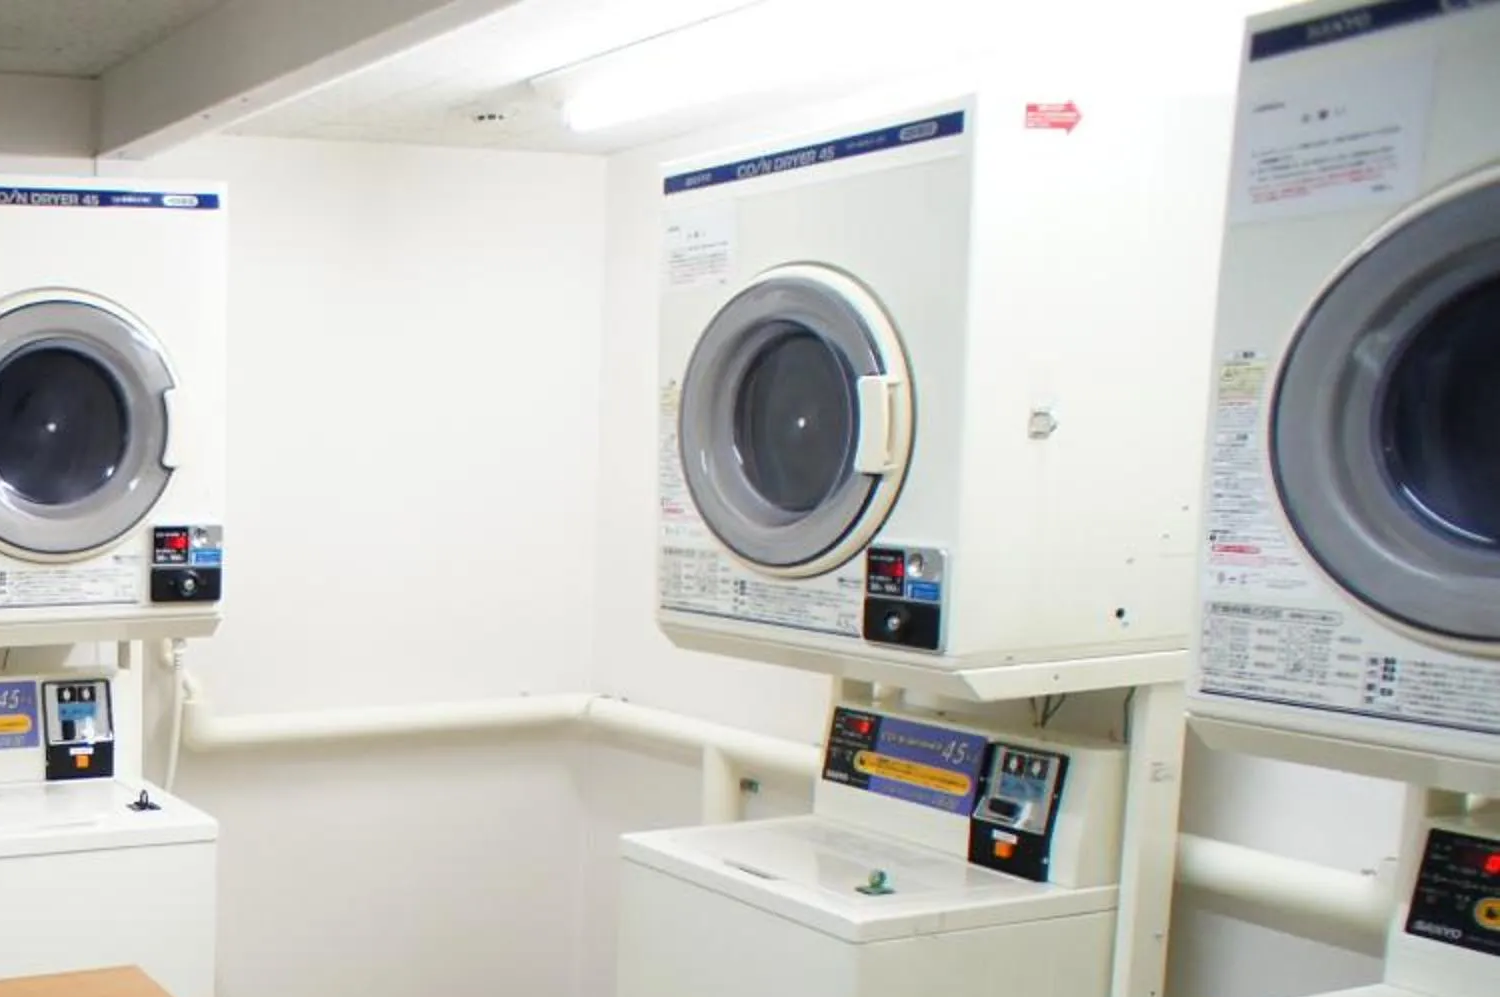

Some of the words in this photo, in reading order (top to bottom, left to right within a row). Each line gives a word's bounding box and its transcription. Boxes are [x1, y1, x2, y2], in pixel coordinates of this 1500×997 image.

[30, 192, 79, 205] DRYER
[82, 194, 99, 206] 45
[1412, 920, 1462, 939] SANYO
